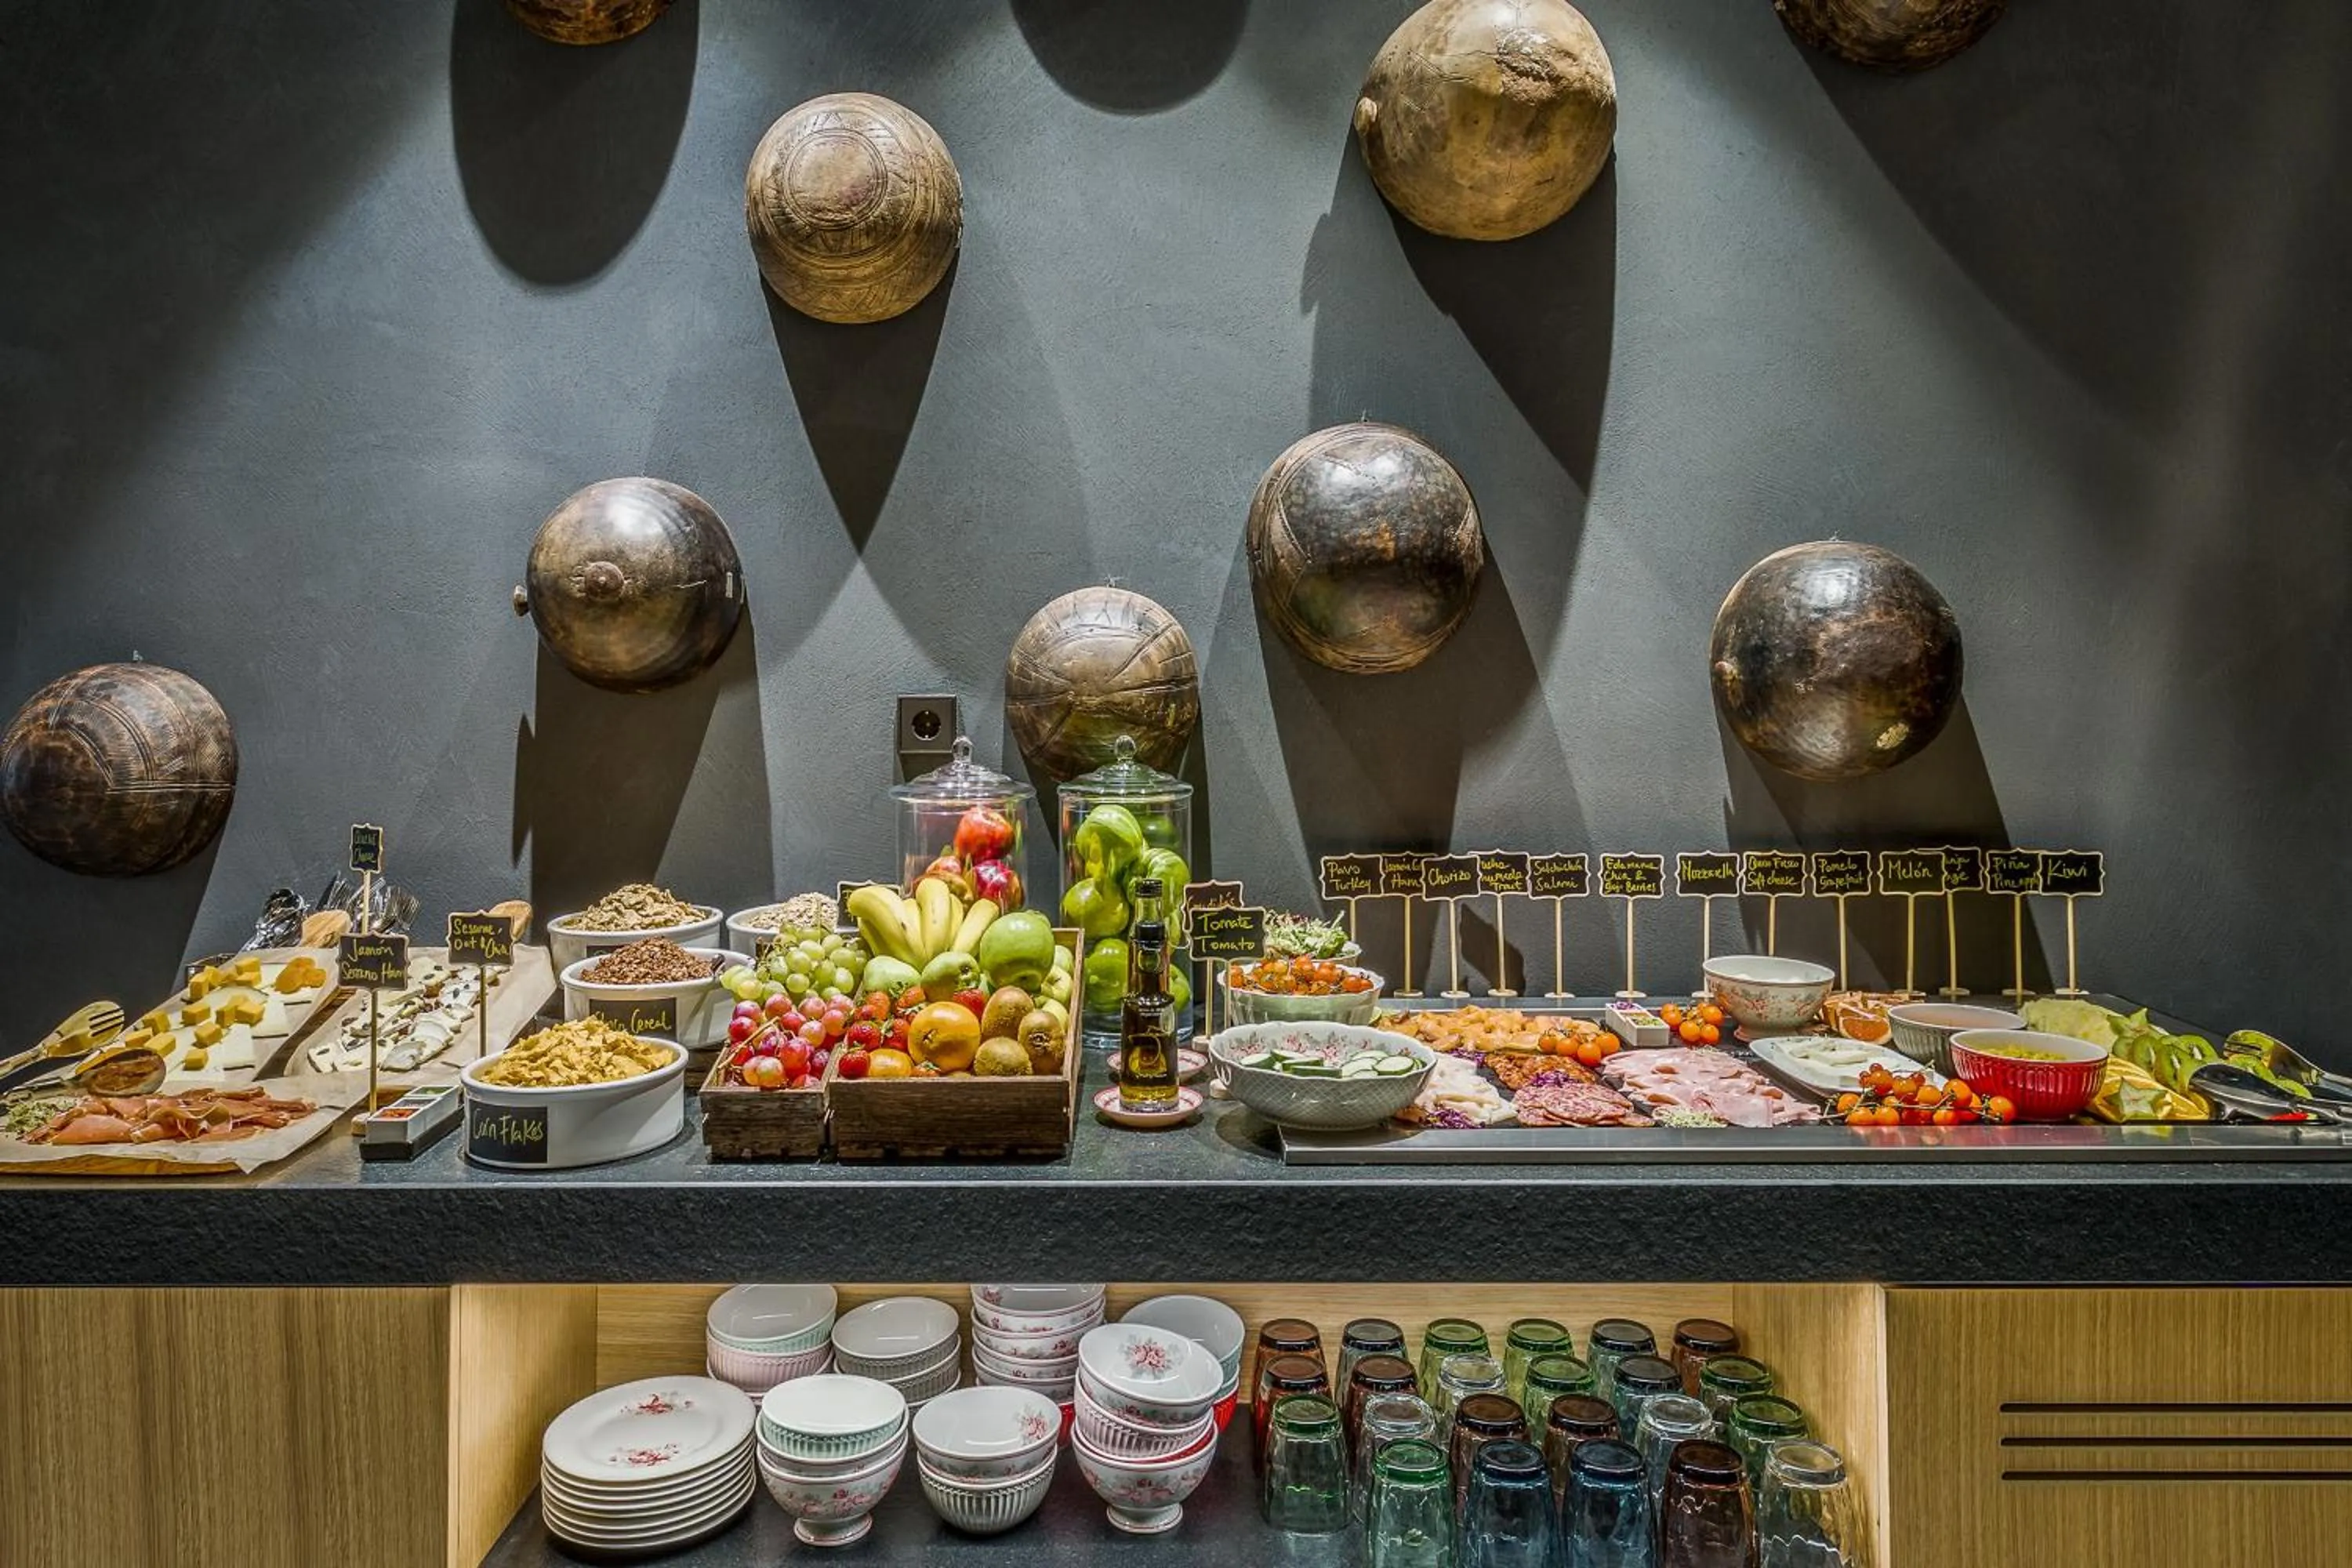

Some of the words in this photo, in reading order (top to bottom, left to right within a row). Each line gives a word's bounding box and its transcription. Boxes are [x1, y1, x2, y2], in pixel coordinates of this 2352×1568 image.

[1327, 862, 1360, 879] Pavo
[1428, 868, 1471, 886] Chorizo
[1888, 859, 1933, 880] Melón
[2047, 858, 2087, 885] Kiwi
[1330, 877, 1371, 894] Turkey
[1196, 912, 1254, 933] Tomate
[347, 938, 394, 962] Jamón
[1192, 935, 1255, 953] Tomato
[341, 961, 378, 982] Serrano
[631, 1008, 672, 1034] Cereal
